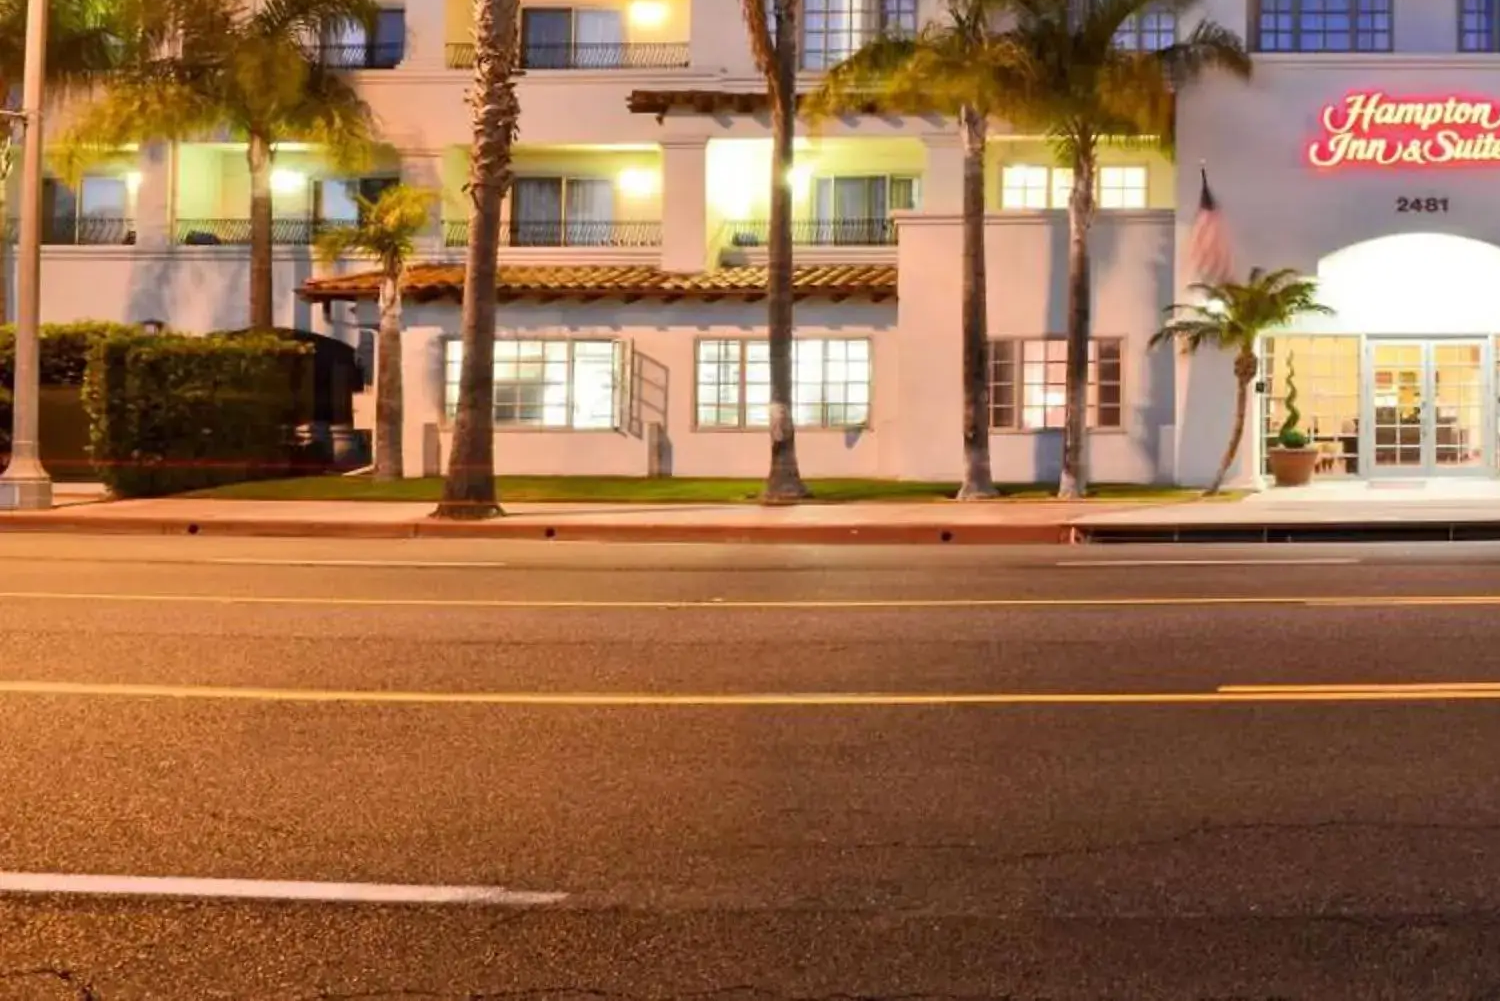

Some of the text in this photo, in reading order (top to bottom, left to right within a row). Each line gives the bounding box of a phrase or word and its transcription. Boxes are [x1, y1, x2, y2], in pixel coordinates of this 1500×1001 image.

[1309, 132, 1402, 166] Inn
[1402, 141, 1425, 164] &
[1396, 197, 1449, 212] 2481
